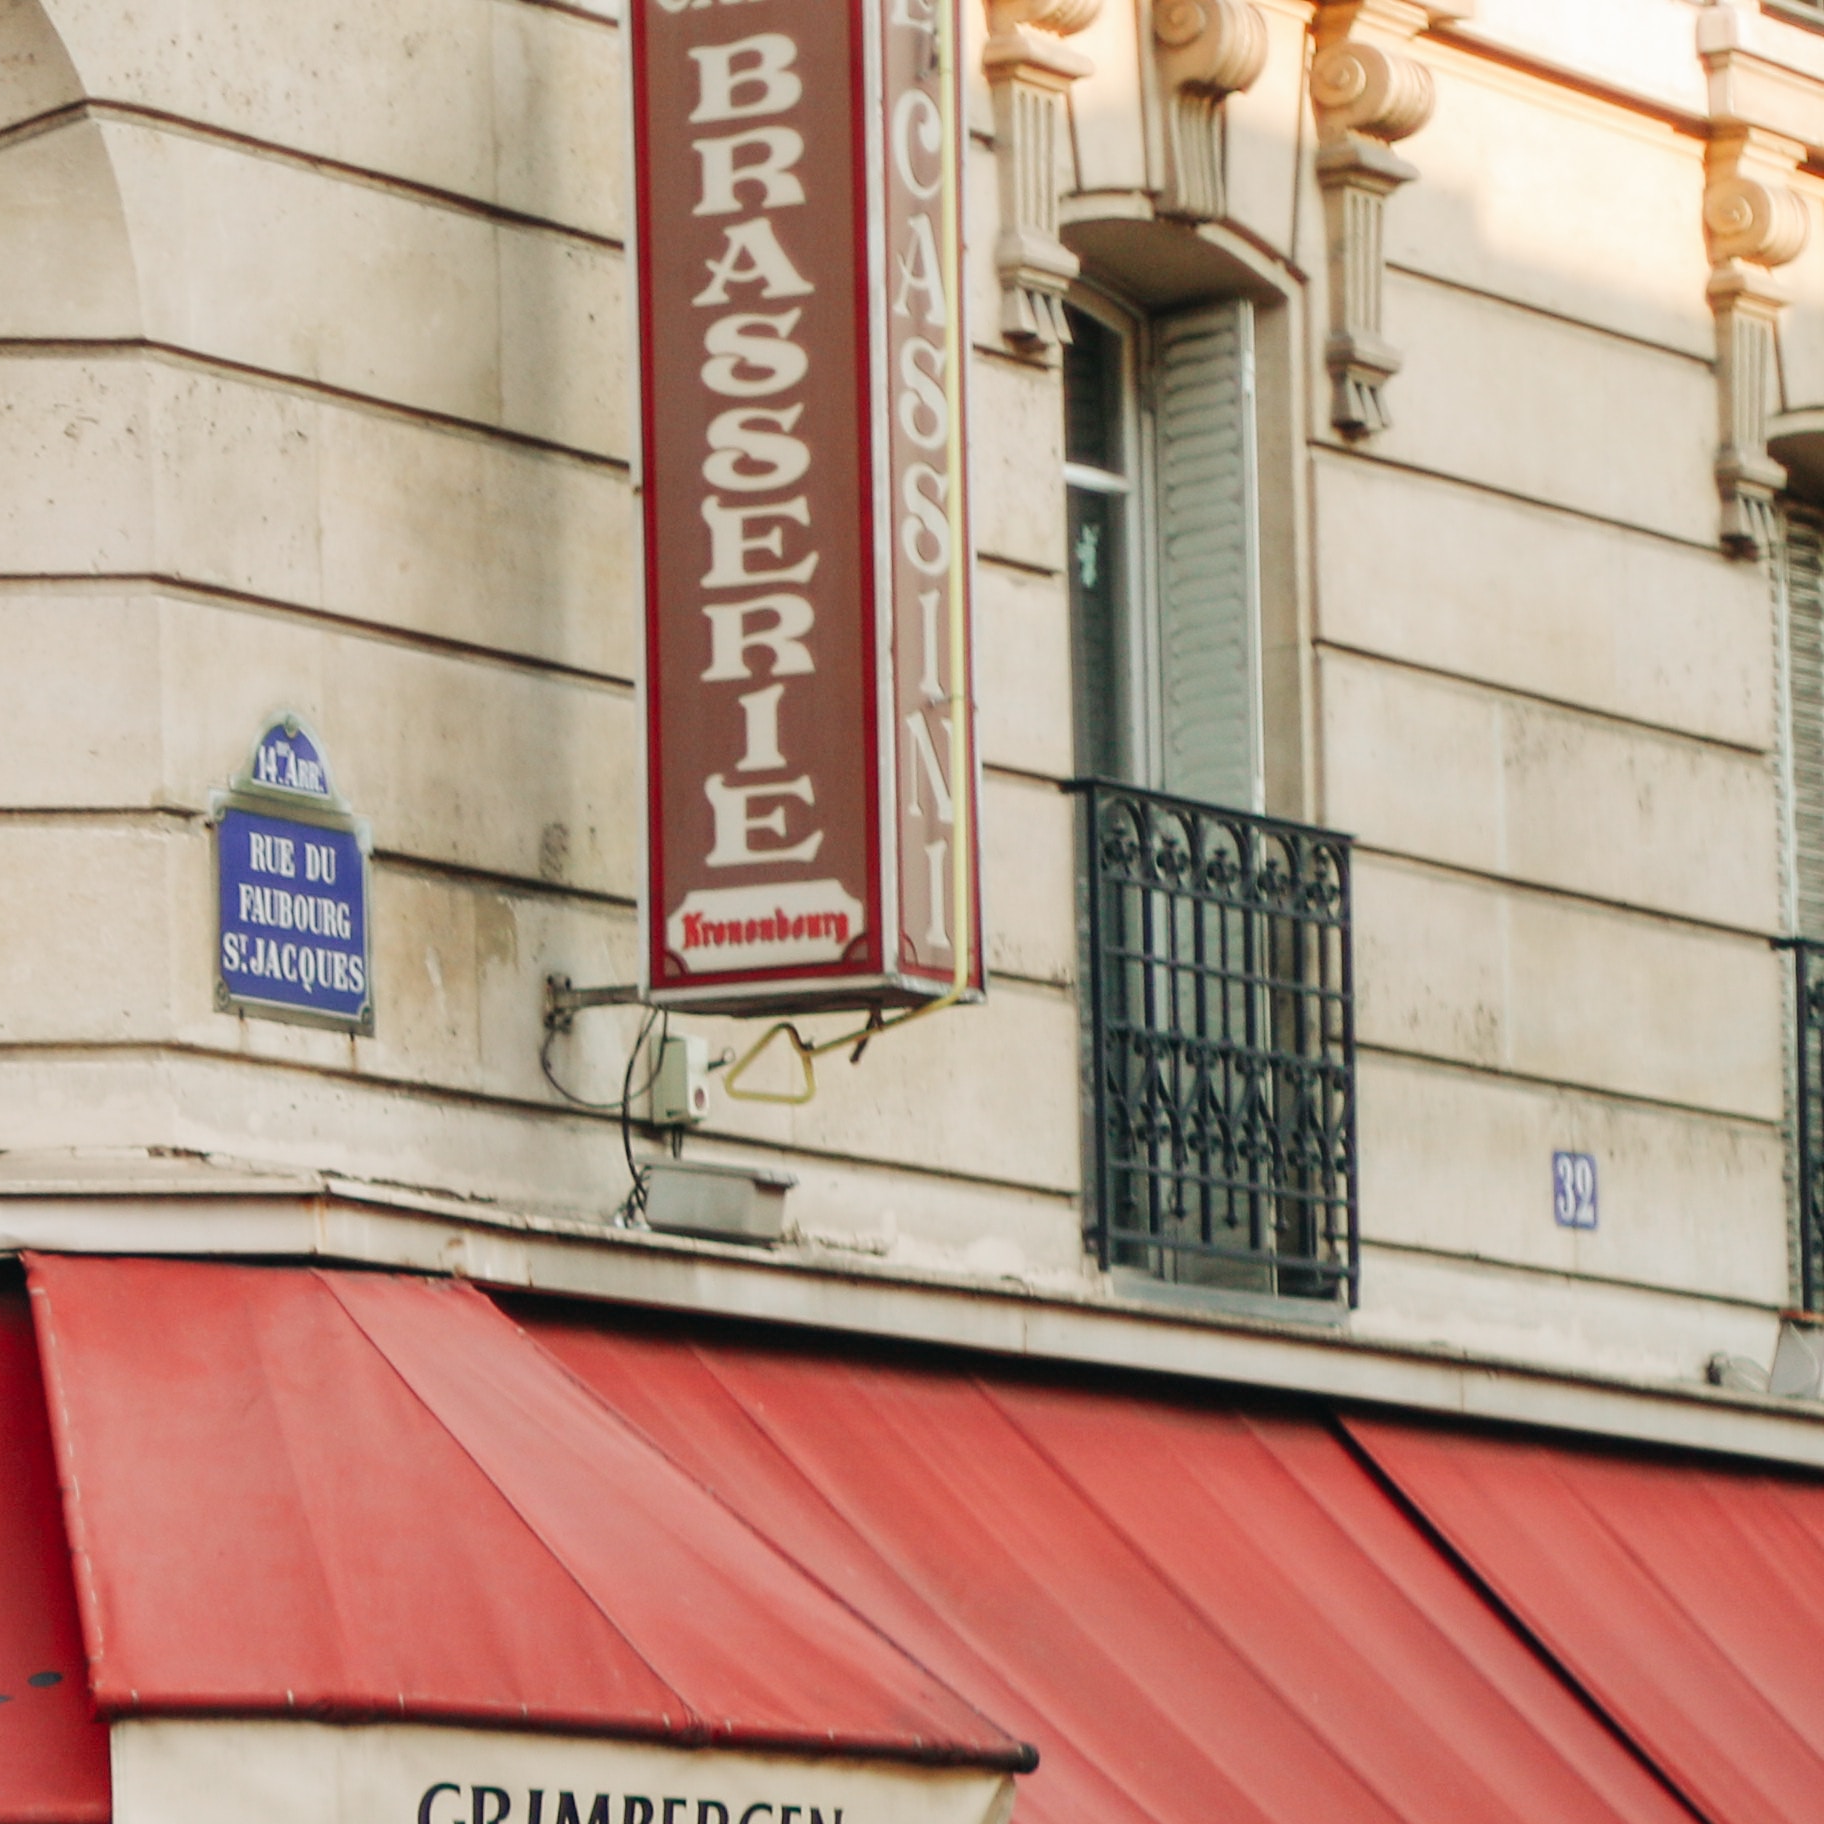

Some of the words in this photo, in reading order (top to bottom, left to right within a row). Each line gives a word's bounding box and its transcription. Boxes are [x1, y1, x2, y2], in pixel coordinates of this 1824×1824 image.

[686, 33, 824, 867] BRASSERIE
[892, 88, 956, 948] CASSINI
[249, 832, 295, 878] RUE
[305, 843, 337, 884] DU
[239, 883, 351, 940] FAUBOURG
[250, 937, 365, 994] JACQUES
[1556, 1155, 1595, 1223] 32
